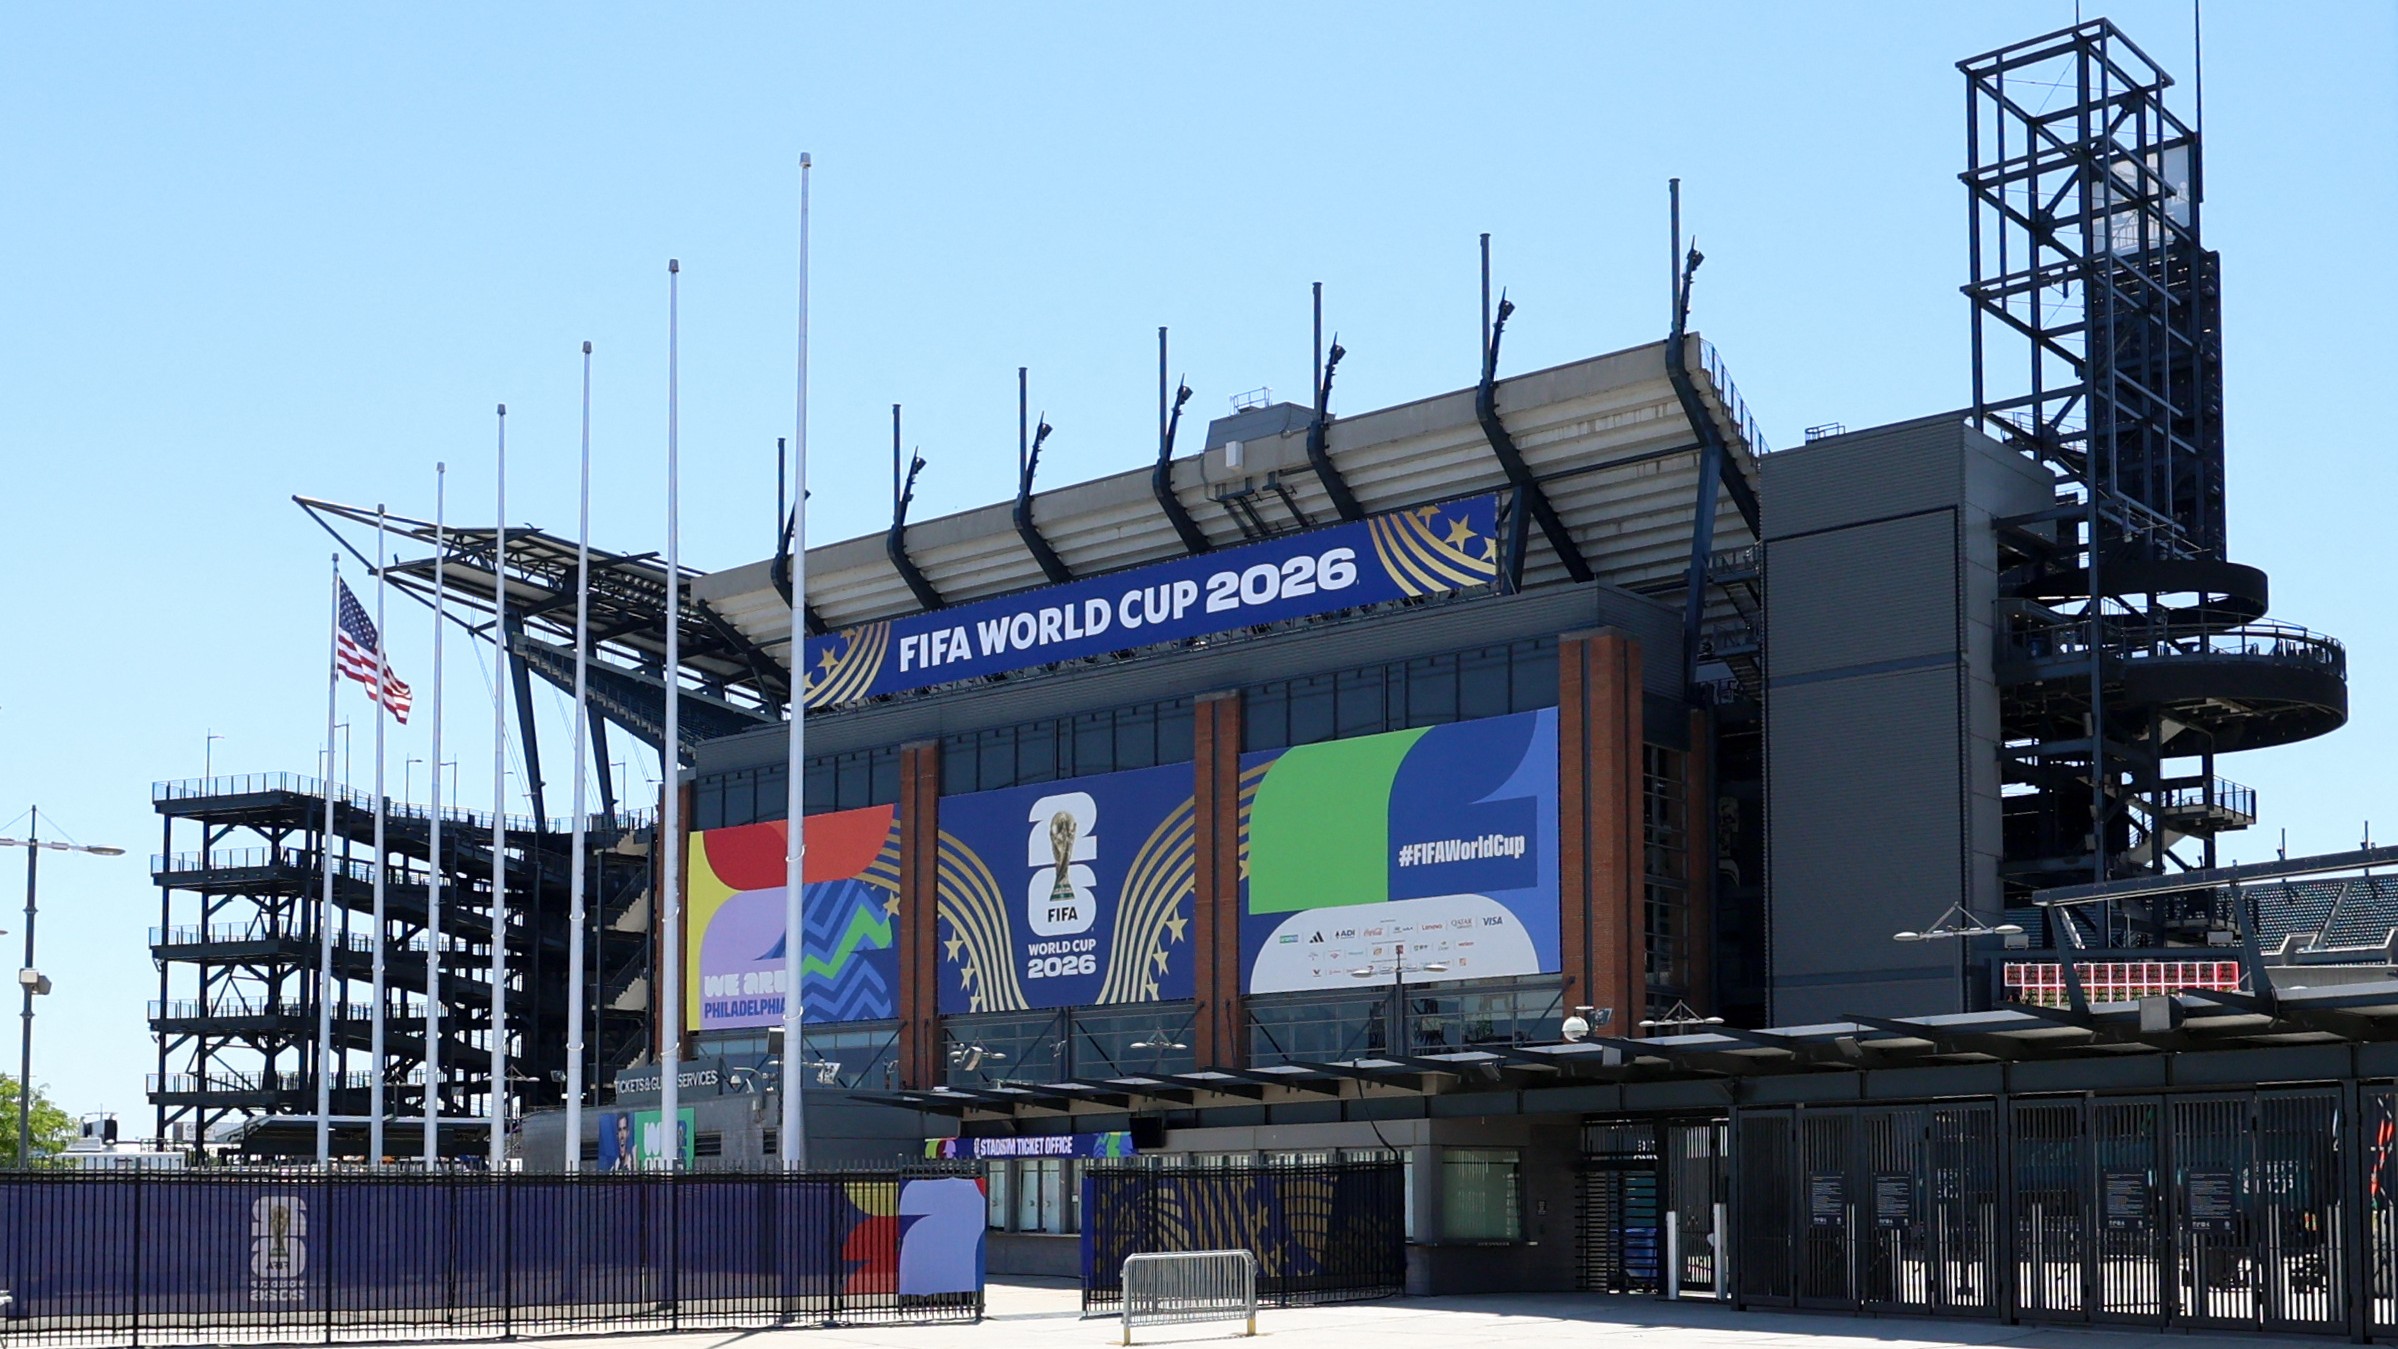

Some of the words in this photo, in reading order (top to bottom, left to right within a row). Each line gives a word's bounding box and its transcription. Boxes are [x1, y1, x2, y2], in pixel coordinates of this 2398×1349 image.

[900, 626, 972, 672] FIFA
[976, 598, 1111, 657] WORLD
[1118, 579, 1198, 629] CUP
[1205, 547, 1357, 613] 2026
[1398, 834, 1525, 867] #FIFAWorldCup
[1047, 906, 1078, 923] FIFA
[1482, 916, 1503, 926] VISA
[1028, 942, 1070, 957] WORLD
[1072, 938, 1097, 952] CUP
[1028, 954, 1097, 979] 2026
[704, 973, 740, 997] WE
[677, 1070, 718, 1088] SERVICES
[1017, 1137, 1044, 1155] TICKET
[1045, 1136, 1073, 1153] OFFICE
